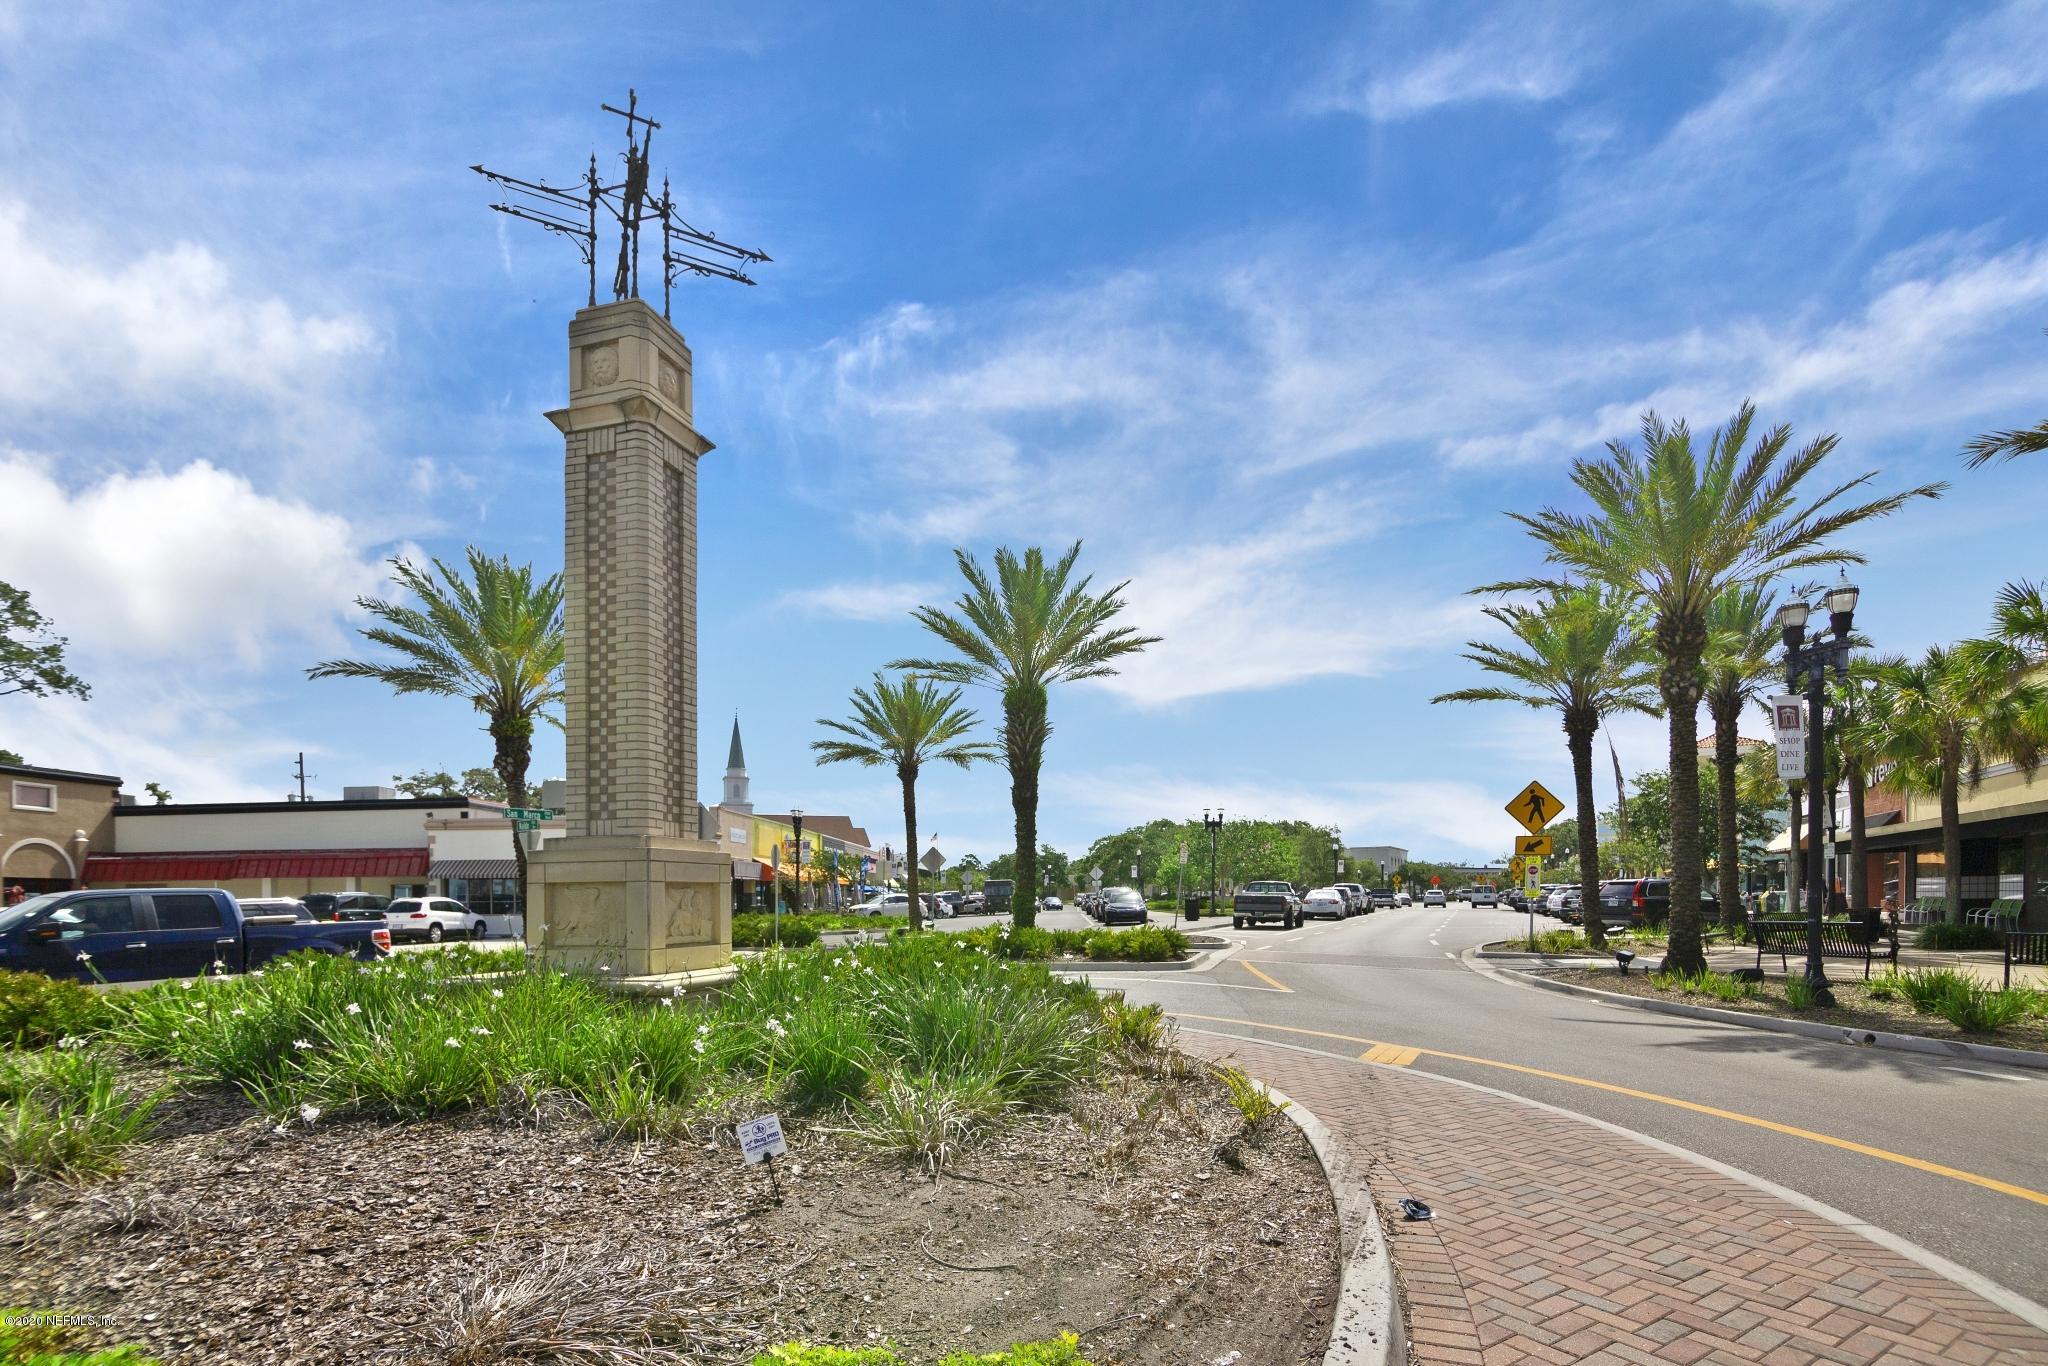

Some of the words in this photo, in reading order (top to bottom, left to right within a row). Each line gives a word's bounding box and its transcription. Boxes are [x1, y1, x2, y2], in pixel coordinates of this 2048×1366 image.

[1779, 737, 1801, 745] SHOP
[1780, 750, 1801, 758] DINE
[1781, 763, 1800, 771] LIVE
[506, 809, 518, 818] San
[523, 810, 541, 820] Marco
[753, 1137, 767, 1145] Bug
